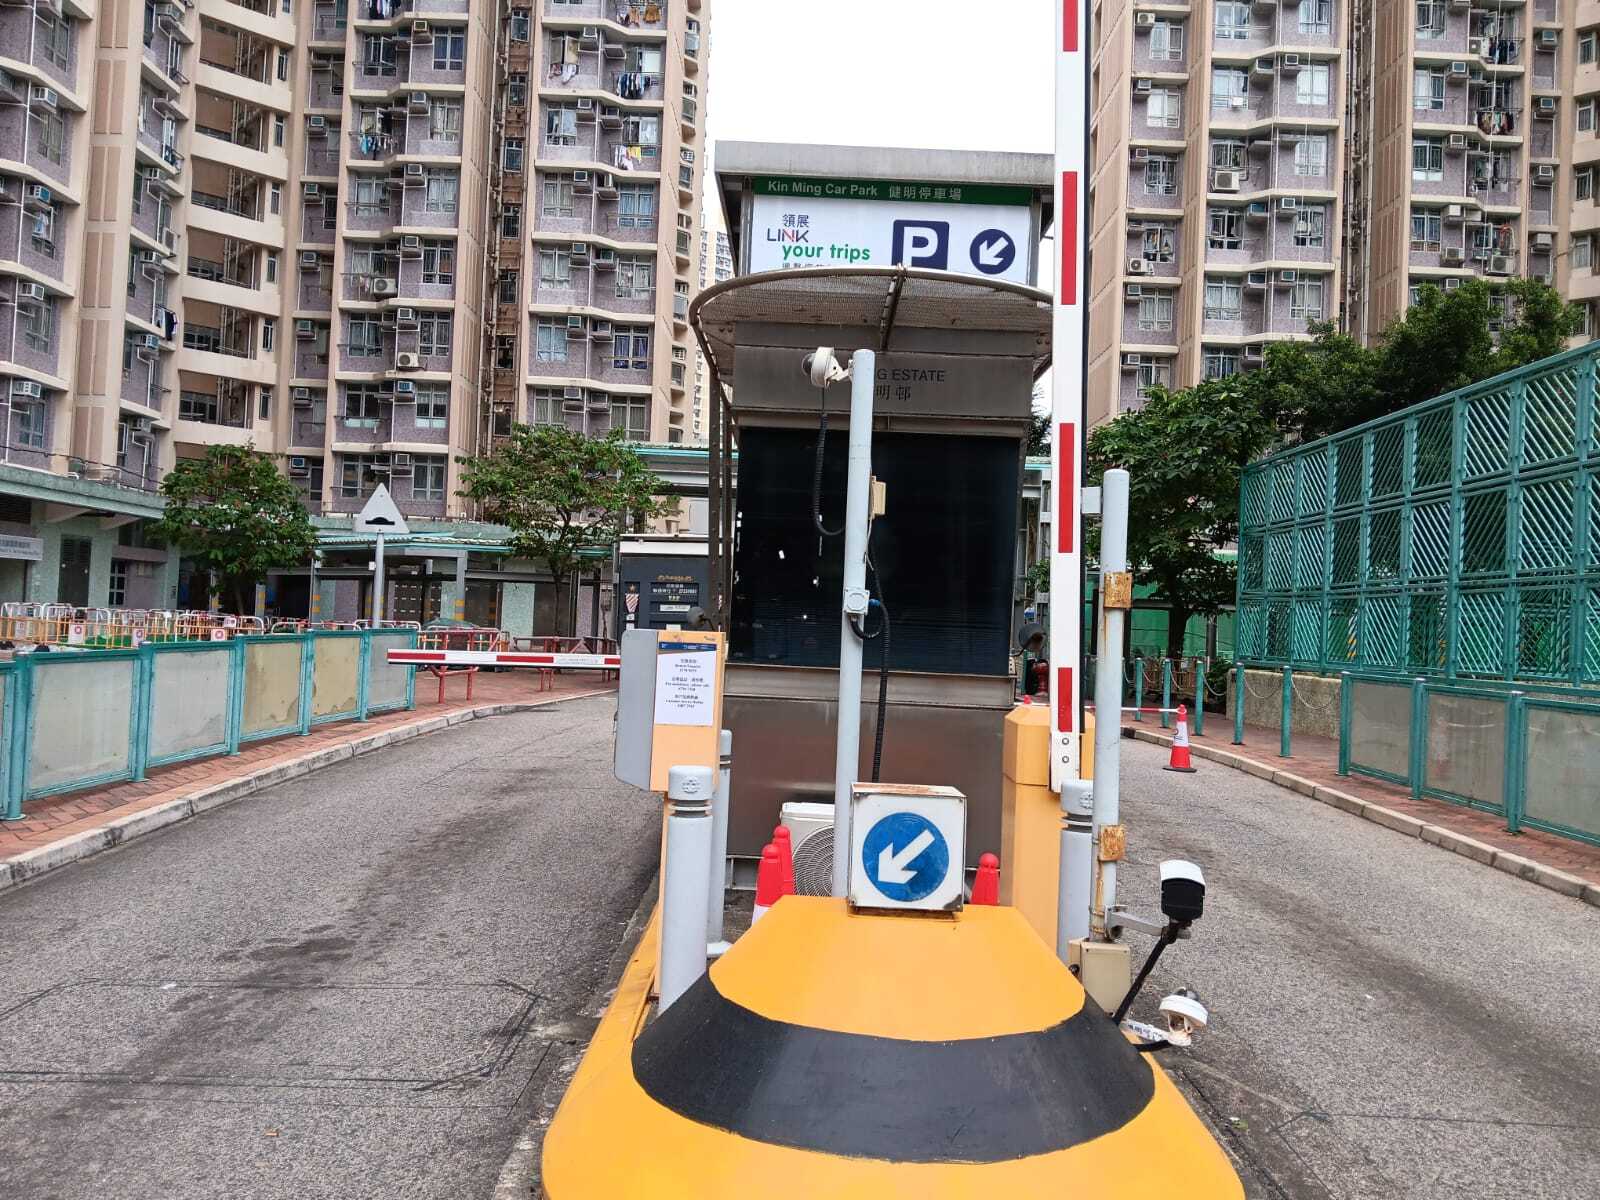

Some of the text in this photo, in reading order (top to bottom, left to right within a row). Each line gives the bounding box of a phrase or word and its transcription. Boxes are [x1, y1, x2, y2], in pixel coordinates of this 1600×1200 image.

[768, 181, 878, 197] Kin Ming Car Park
[889, 185, 962, 201] 健明停車場
[782, 213, 810, 228] 領展
[766, 228, 810, 243] LINK
[782, 244, 871, 263] your trips
[891, 368, 945, 382] ESTATE
[876, 384, 912, 401] 明邨
